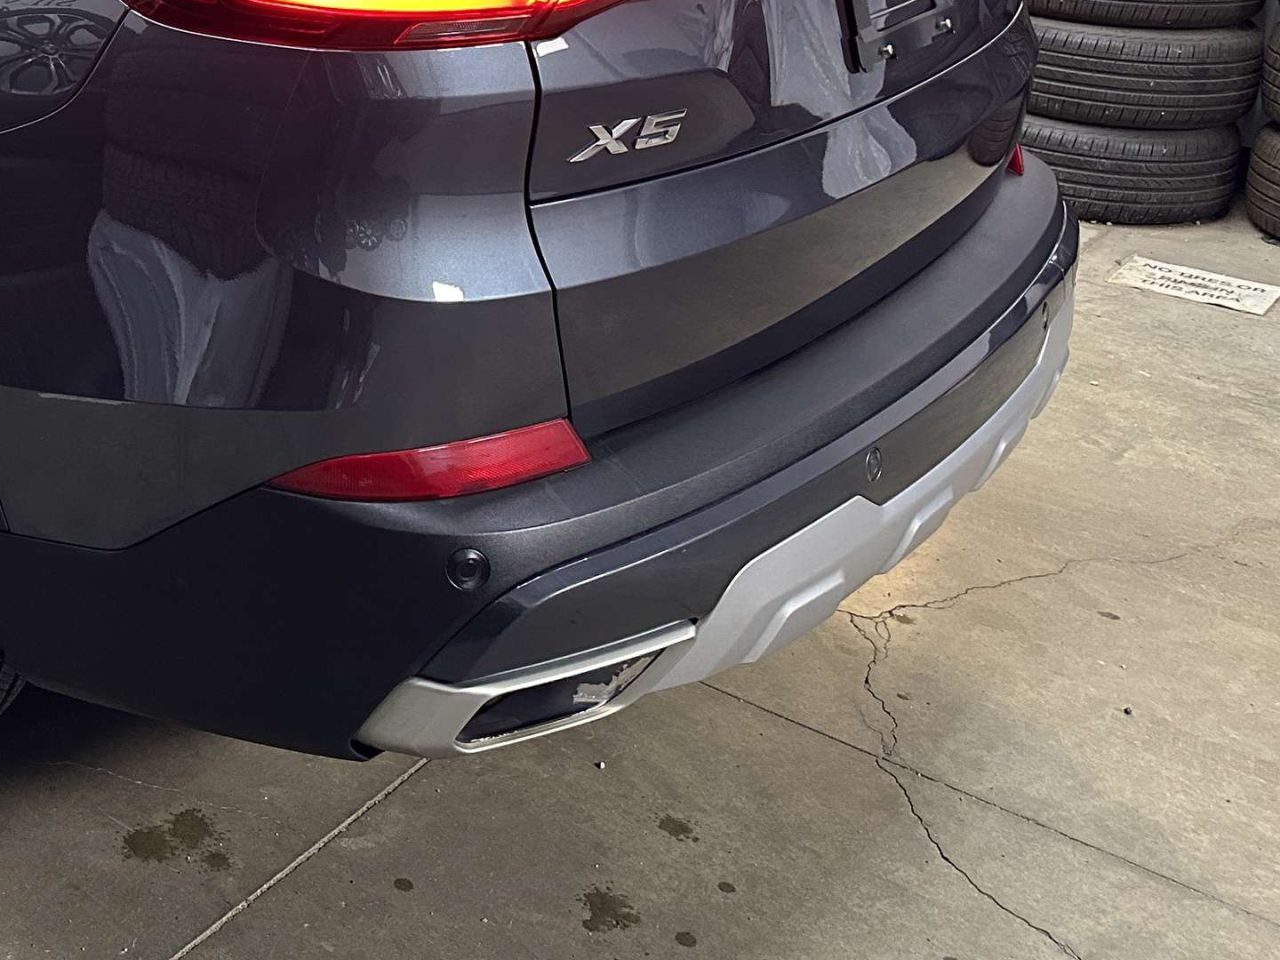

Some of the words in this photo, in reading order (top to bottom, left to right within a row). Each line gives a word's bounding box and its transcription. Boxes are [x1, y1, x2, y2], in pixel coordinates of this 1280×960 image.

[567, 107, 687, 163] X5
[1141, 279, 1183, 290] THIS
[1143, 263, 1172, 273] NO
[1236, 284, 1266, 293] OR
